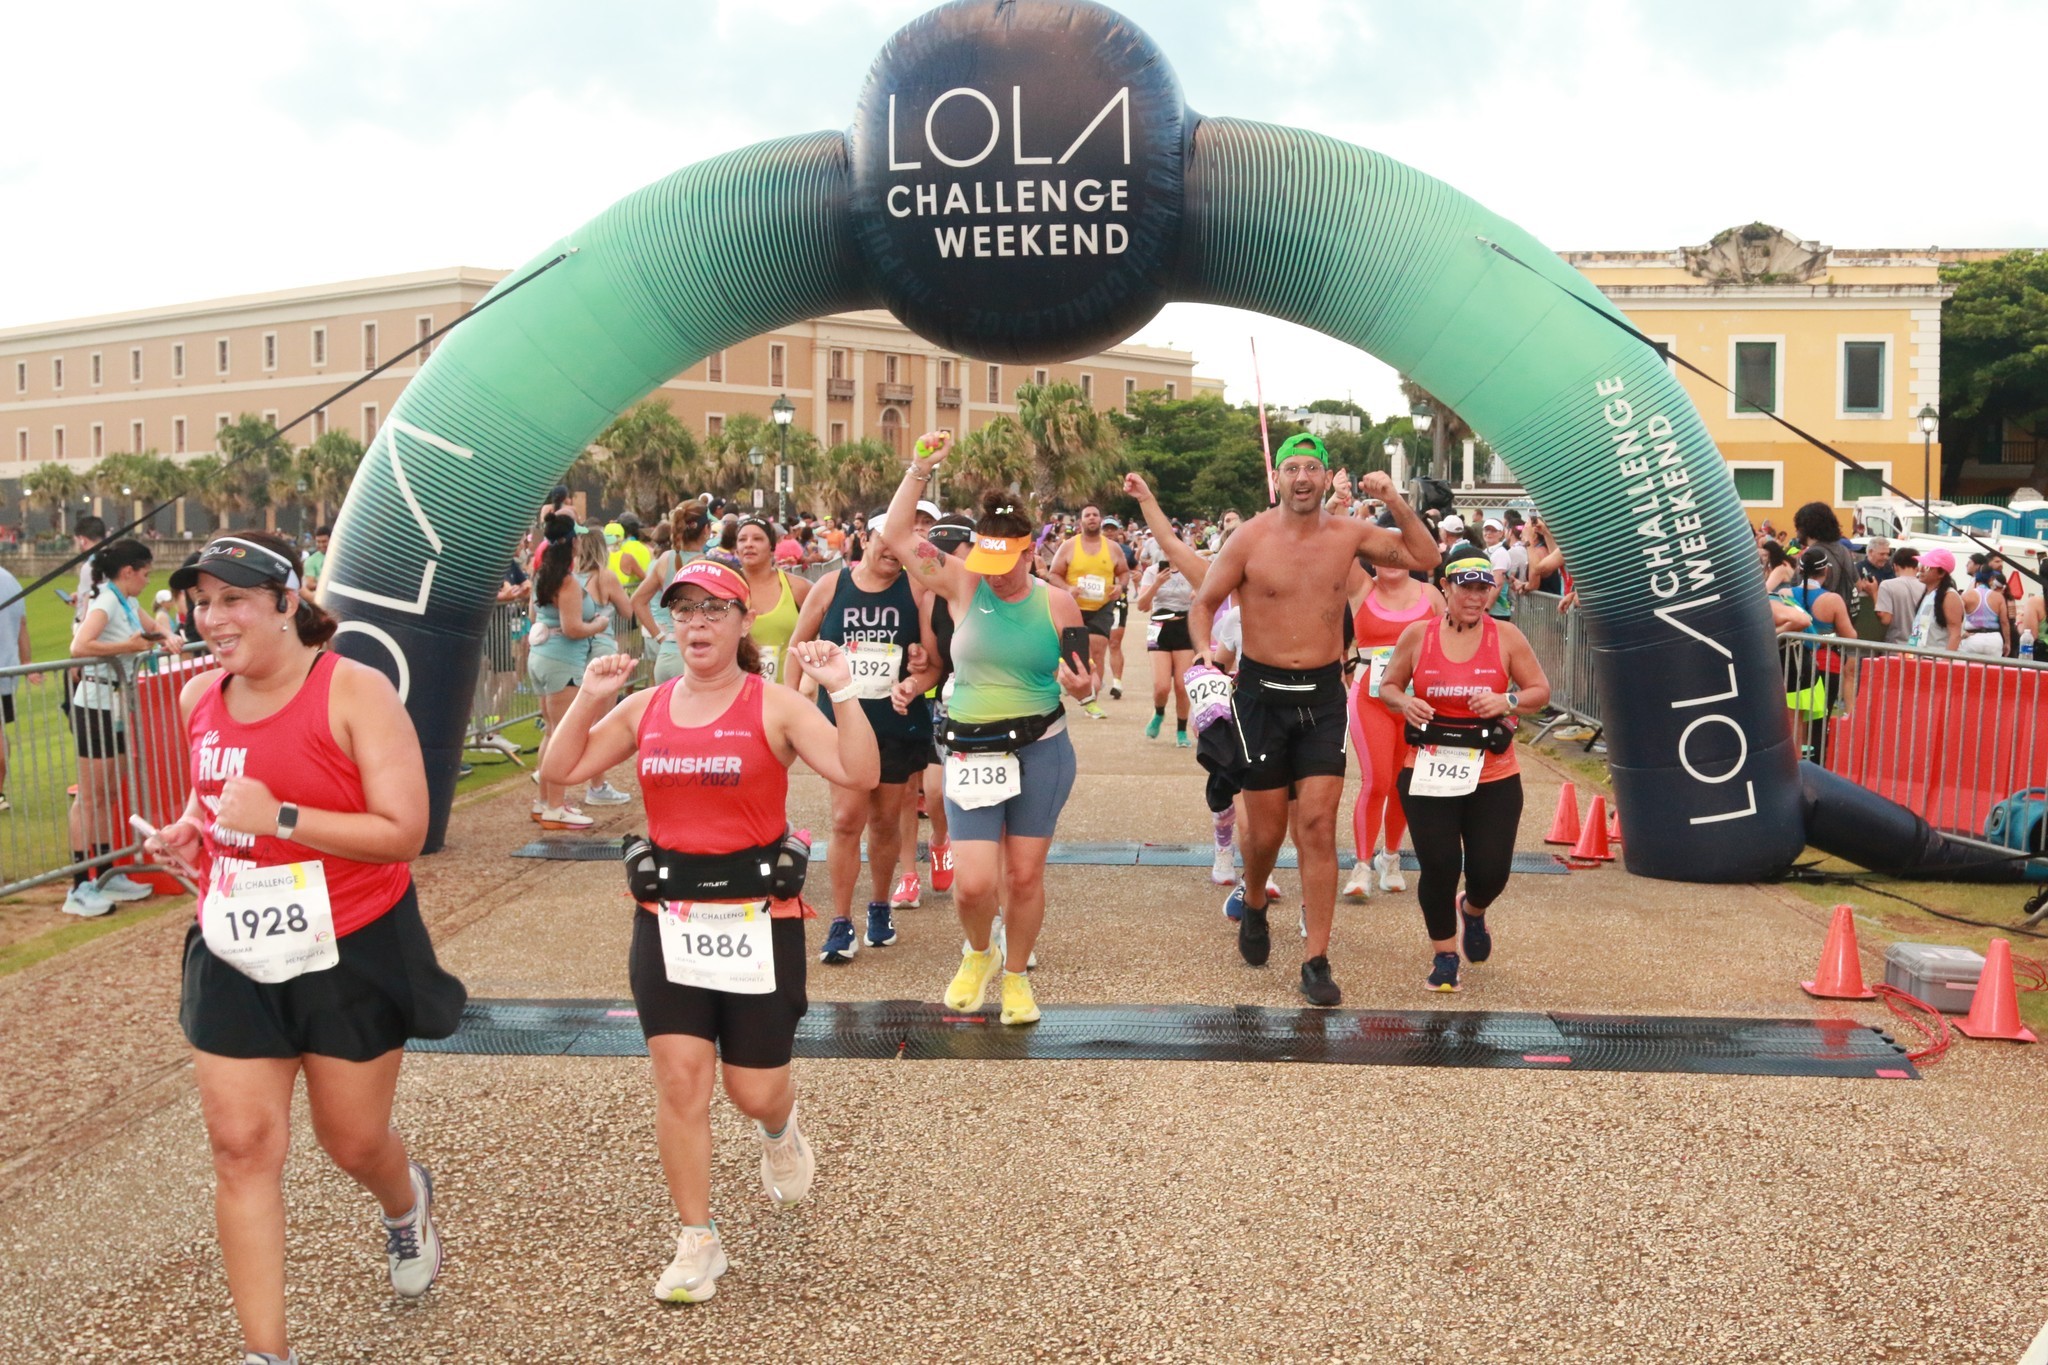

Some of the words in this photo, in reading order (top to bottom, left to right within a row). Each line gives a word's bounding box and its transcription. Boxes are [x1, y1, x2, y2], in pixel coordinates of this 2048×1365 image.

[889, 86, 1130, 171] LOLA
[887, 179, 1128, 218] CHALLENGE
[935, 224, 1128, 258] WEEKEND
[1597, 376, 1680, 598] CHALLENGE
[1648, 415, 1715, 591] WEEKEND
[1457, 571, 1496, 585] LOL
[843, 606, 900, 628] RUN
[843, 629, 898, 643] HAPPY
[851, 660, 891, 677] 1392
[1654, 594, 1757, 824] LOLA
[199, 747, 248, 781] RUN
[642, 756, 742, 776] FINISHER
[958, 766, 1007, 785] 2138
[1428, 762, 1471, 779] 1945
[245, 875, 300, 889] CHALLENGE
[225, 903, 309, 941] 1928
[701, 911, 749, 920] CHALLENGE
[681, 933, 753, 958] 1886
